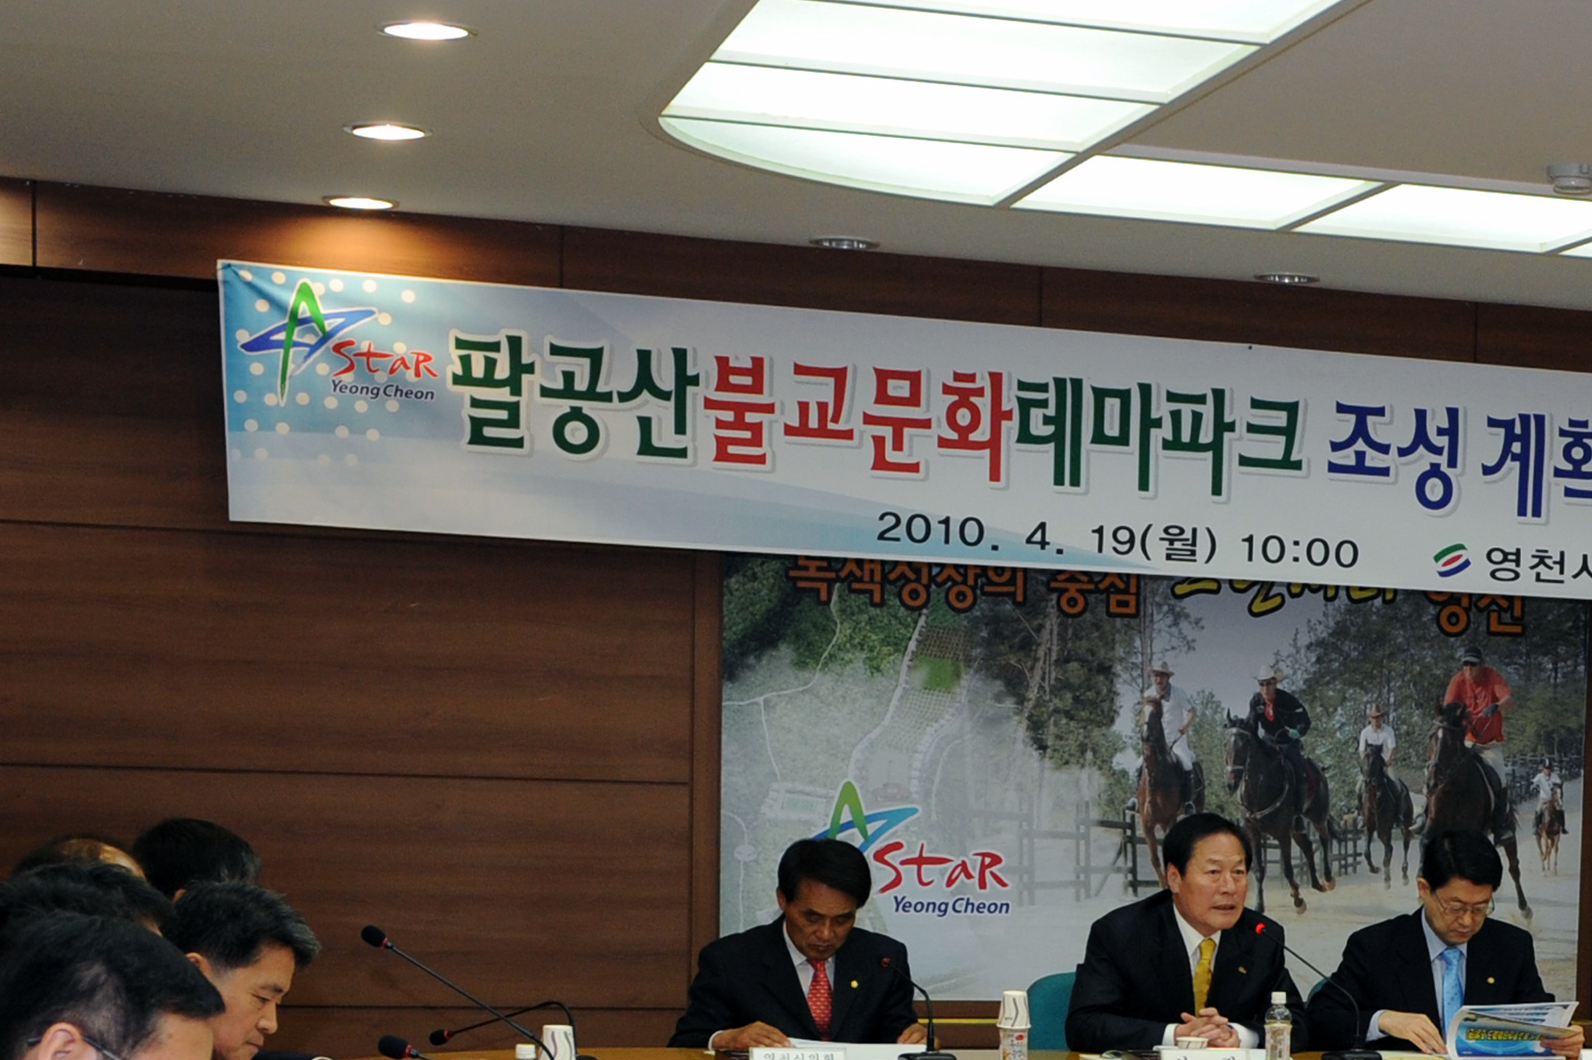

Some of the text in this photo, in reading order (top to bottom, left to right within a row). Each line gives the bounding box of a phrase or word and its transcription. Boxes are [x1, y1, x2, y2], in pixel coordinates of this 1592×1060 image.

[1326, 401, 1460, 511] 조성
[876, 511, 1360, 569] 2010. 4. 19(월) 10:00
